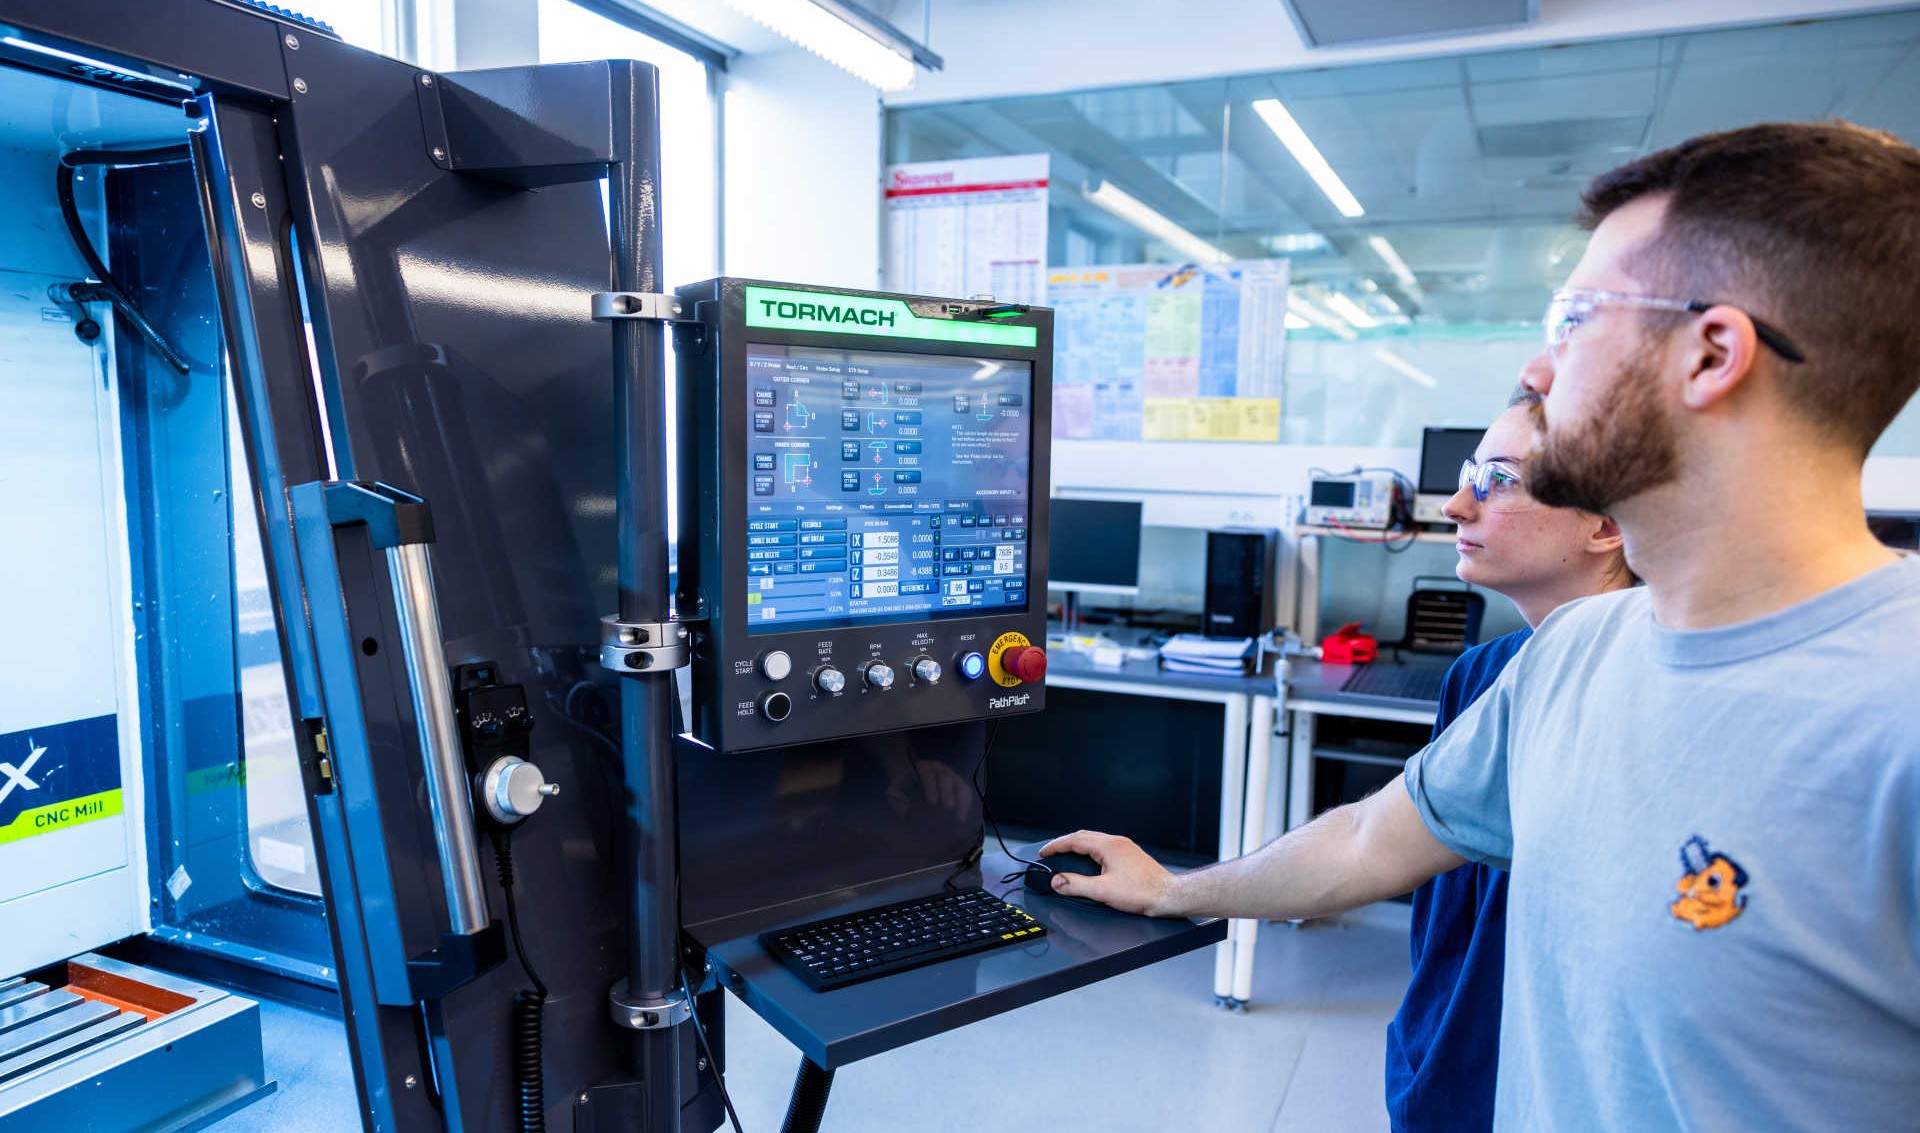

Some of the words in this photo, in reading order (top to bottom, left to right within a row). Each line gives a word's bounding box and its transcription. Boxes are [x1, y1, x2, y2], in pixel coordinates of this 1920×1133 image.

[760, 299, 895, 327] TORMACH
[912, 534, 933, 543] 0.0000
[912, 551, 933, 559] 0.0000
[877, 584, 898, 594] 0.0000
[901, 584, 925, 592] REFERENCE
[911, 638, 935, 646] VELOCITY
[993, 634, 1030, 655] EMERGENC
[818, 647, 833, 655] RATE
[735, 659, 753, 668] CYCLE
[735, 666, 753, 675] START
[738, 701, 754, 709] FEED
[989, 694, 1027, 709] PathPilot
[737, 708, 754, 716] HOLD
[35, 808, 70, 828] CNC
[75, 800, 103, 818] Mill
